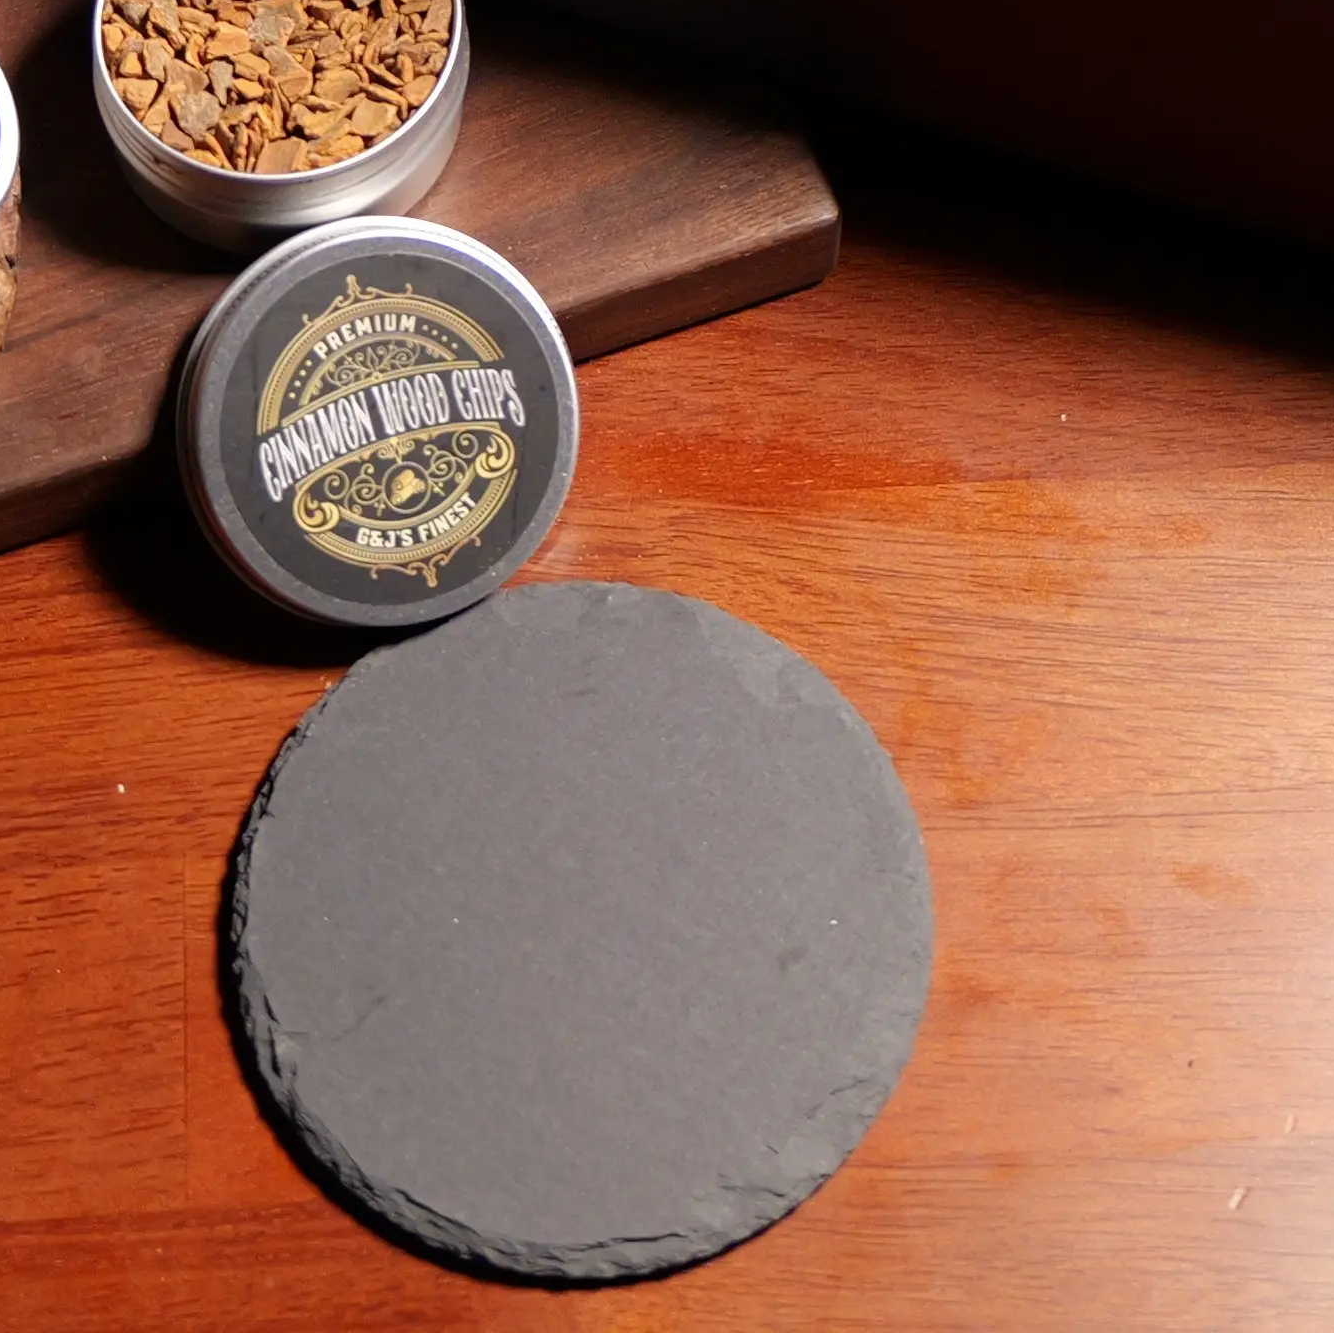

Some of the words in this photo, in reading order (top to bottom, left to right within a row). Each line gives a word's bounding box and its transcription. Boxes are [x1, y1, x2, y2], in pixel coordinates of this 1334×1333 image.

[312, 313, 418, 361] PREMIUM
[258, 389, 377, 503] CINNAMON
[371, 371, 451, 436] WOOD
[451, 367, 526, 427] CHIPS
[356, 524, 414, 549] G&J'S
[418, 491, 478, 546] FINEST
